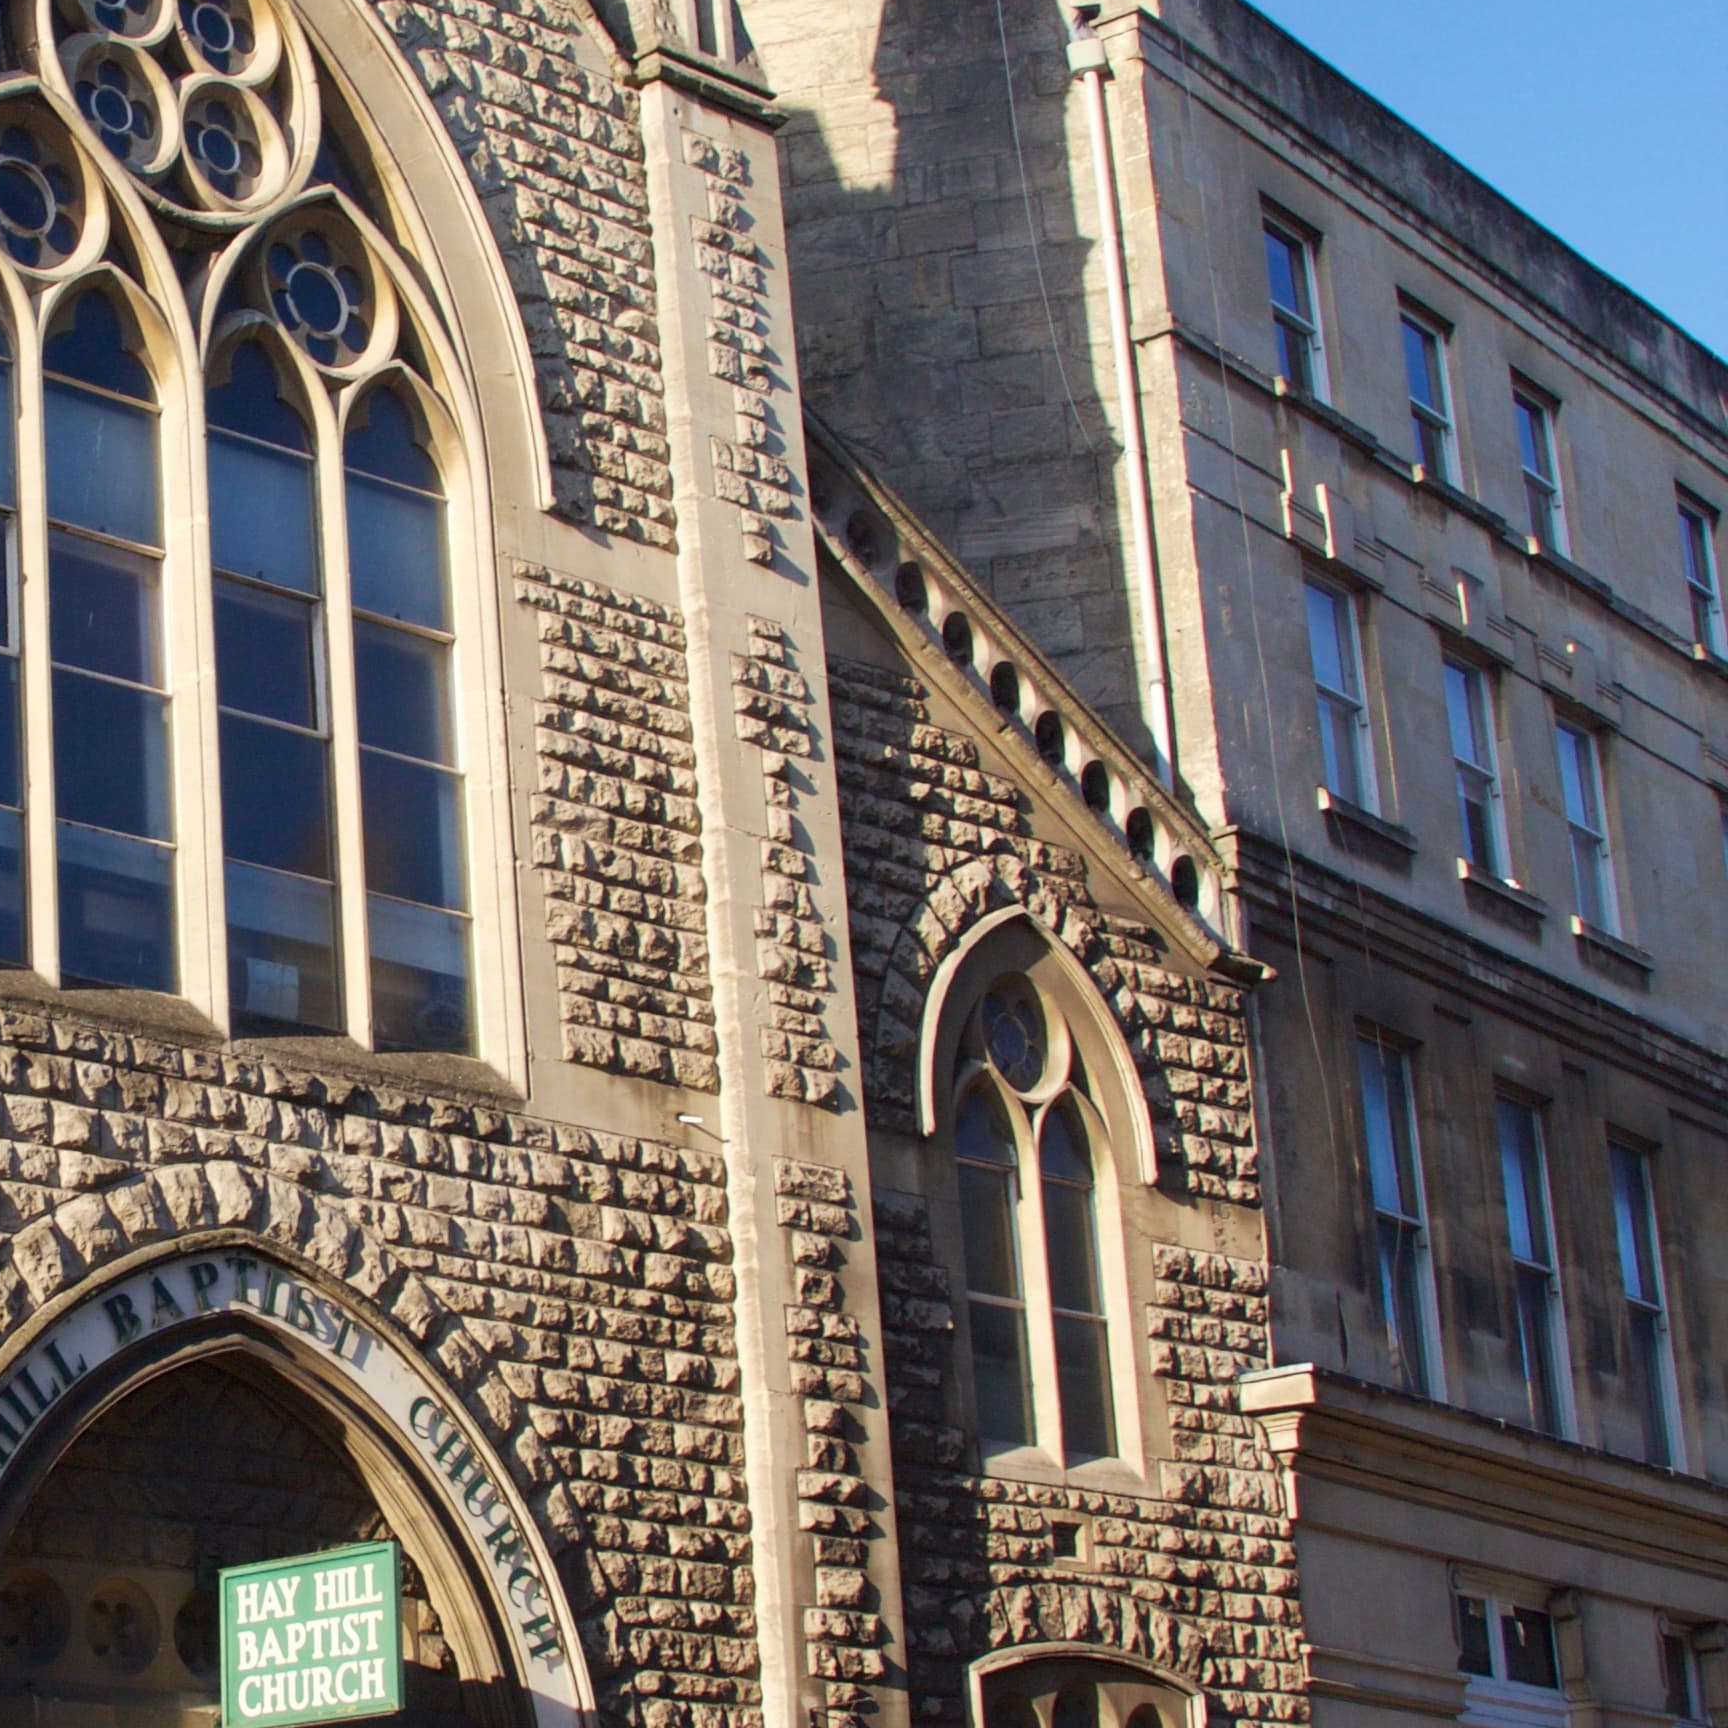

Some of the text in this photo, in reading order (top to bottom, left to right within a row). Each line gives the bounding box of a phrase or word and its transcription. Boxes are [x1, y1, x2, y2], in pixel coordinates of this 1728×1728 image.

[103, 1256, 364, 1358] BAPTIST
[410, 1396, 563, 1663] CHURCH
[236, 1564, 383, 1625] HAY HILL
[237, 1610, 383, 1671] BAPTIST
[238, 1658, 385, 1718] CHURCH
